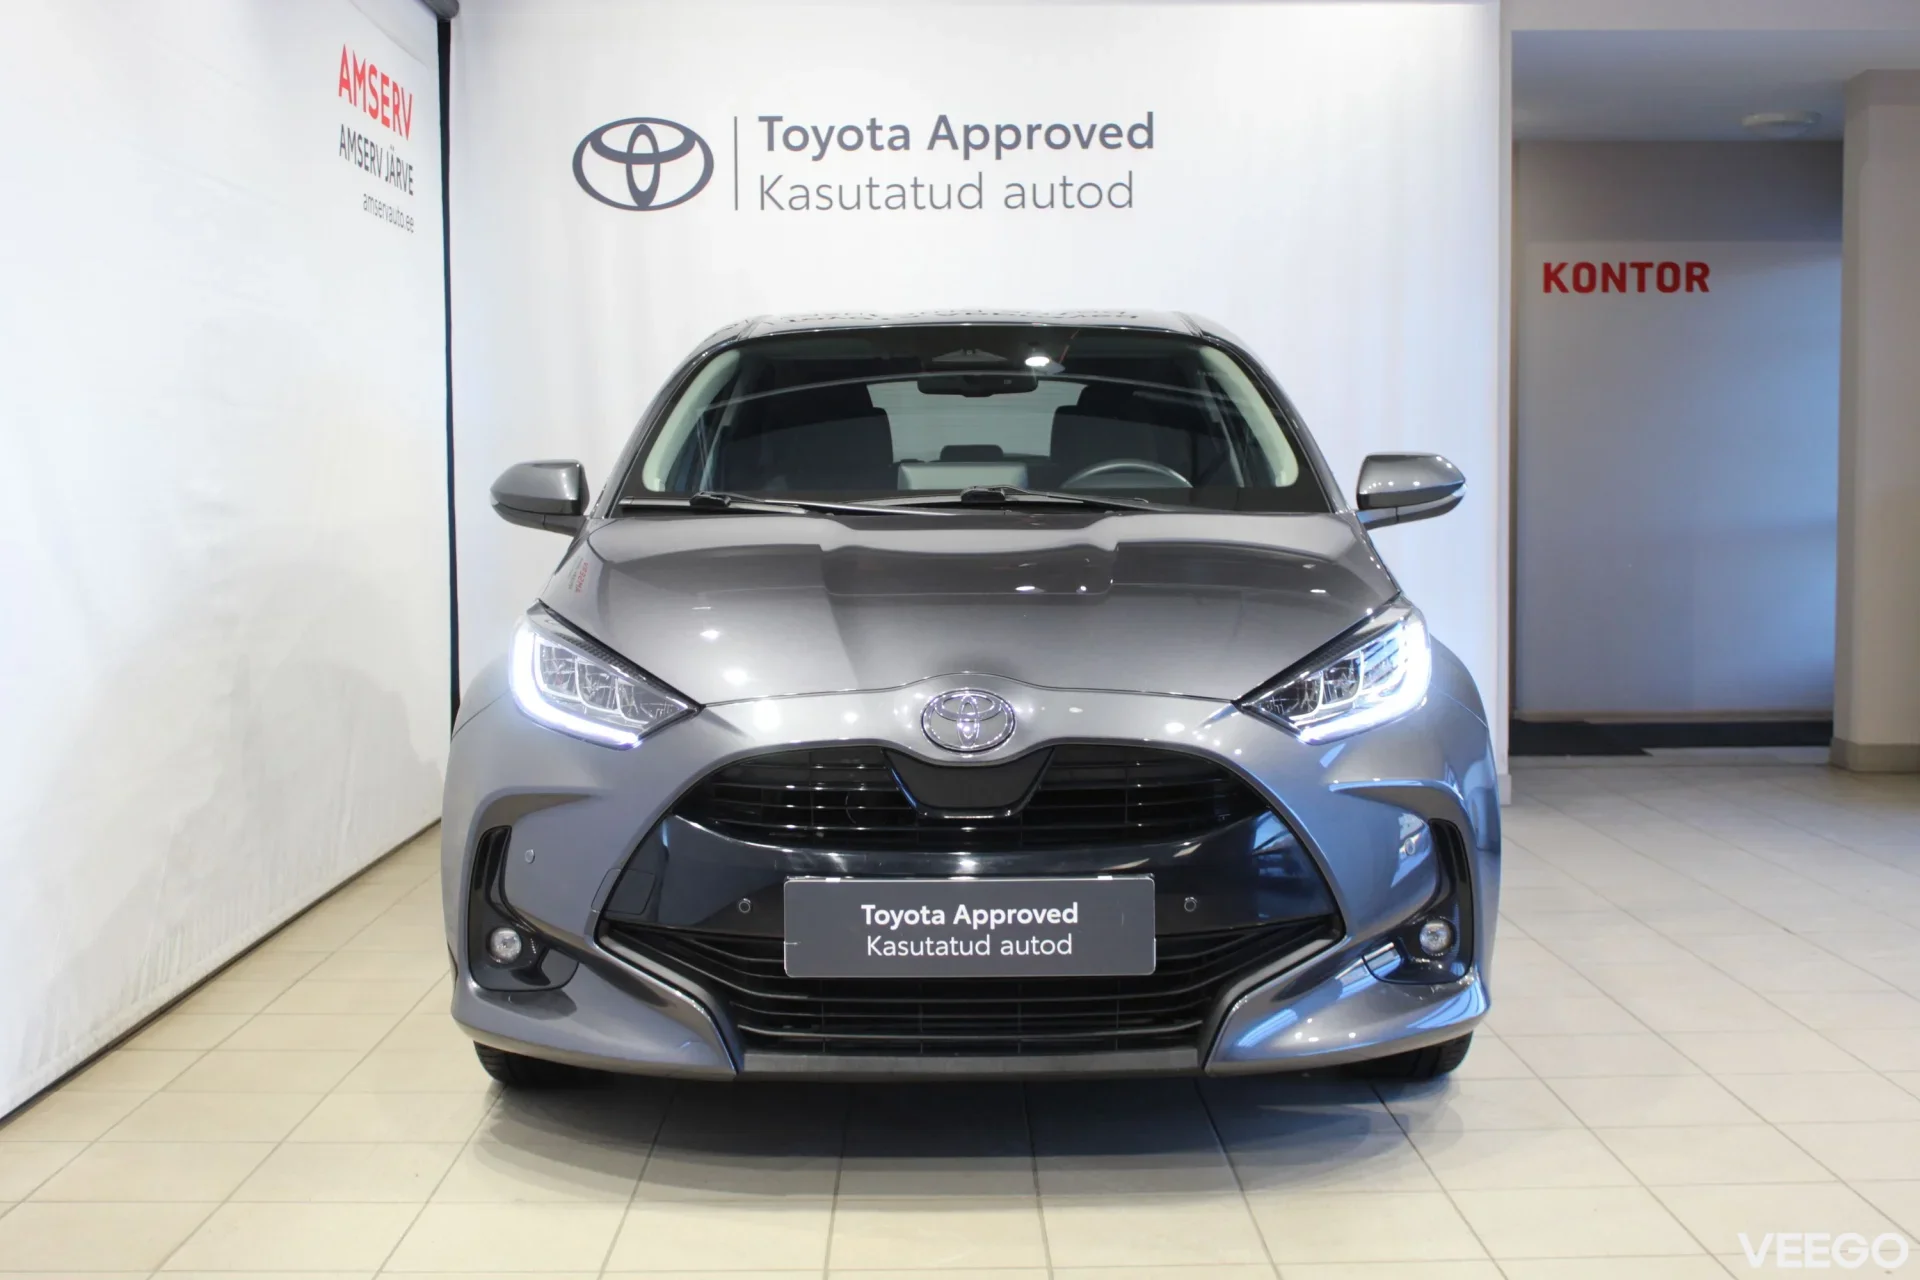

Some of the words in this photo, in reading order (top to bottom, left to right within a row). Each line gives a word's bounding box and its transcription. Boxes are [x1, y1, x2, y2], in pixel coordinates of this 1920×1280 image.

[338, 43, 413, 140] AMSERV
[758, 115, 911, 161] Toyota
[926, 111, 1154, 160] Approved
[339, 123, 384, 178] AMSERV
[384, 143, 414, 196] JÄRVE
[760, 171, 983, 211] Kasutatud
[1003, 170, 1133, 209] autod
[362, 192, 415, 234] amservauto.ee
[1542, 261, 1710, 294] KONTOR
[861, 904, 945, 930] Toyota
[952, 902, 1079, 930] Approved
[867, 935, 991, 957] Kasutatud
[999, 933, 1073, 956] autod
